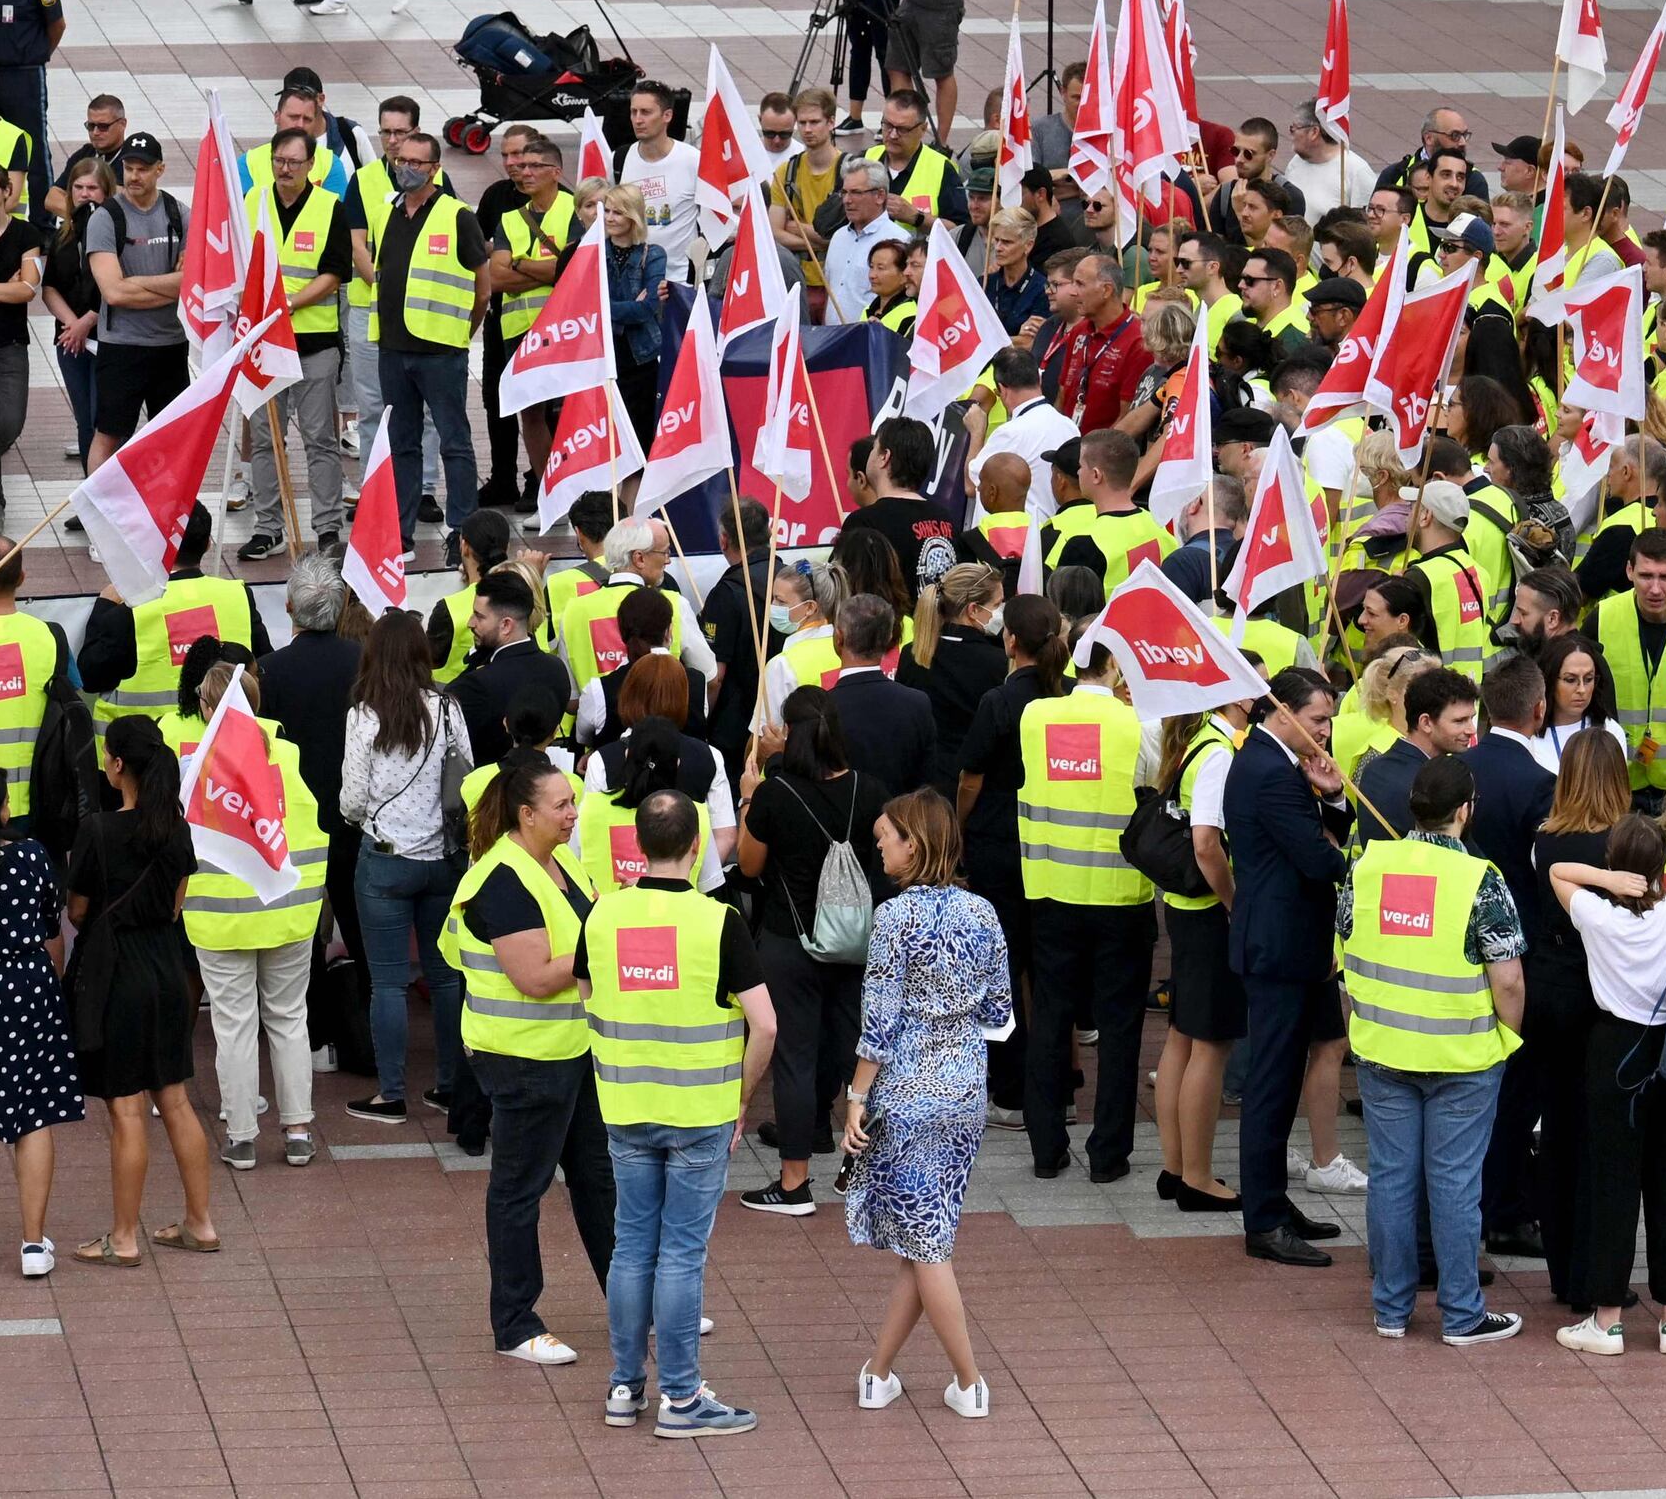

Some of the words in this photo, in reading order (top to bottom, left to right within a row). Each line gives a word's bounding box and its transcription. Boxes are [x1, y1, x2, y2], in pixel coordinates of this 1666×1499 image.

[913, 523, 940, 541] SONS
[941, 520, 955, 540] OF
[1049, 757, 1097, 774] ver.di
[204, 777, 286, 852] ver.di
[1382, 909, 1430, 929] ver.di
[621, 964, 674, 982] ver.di
